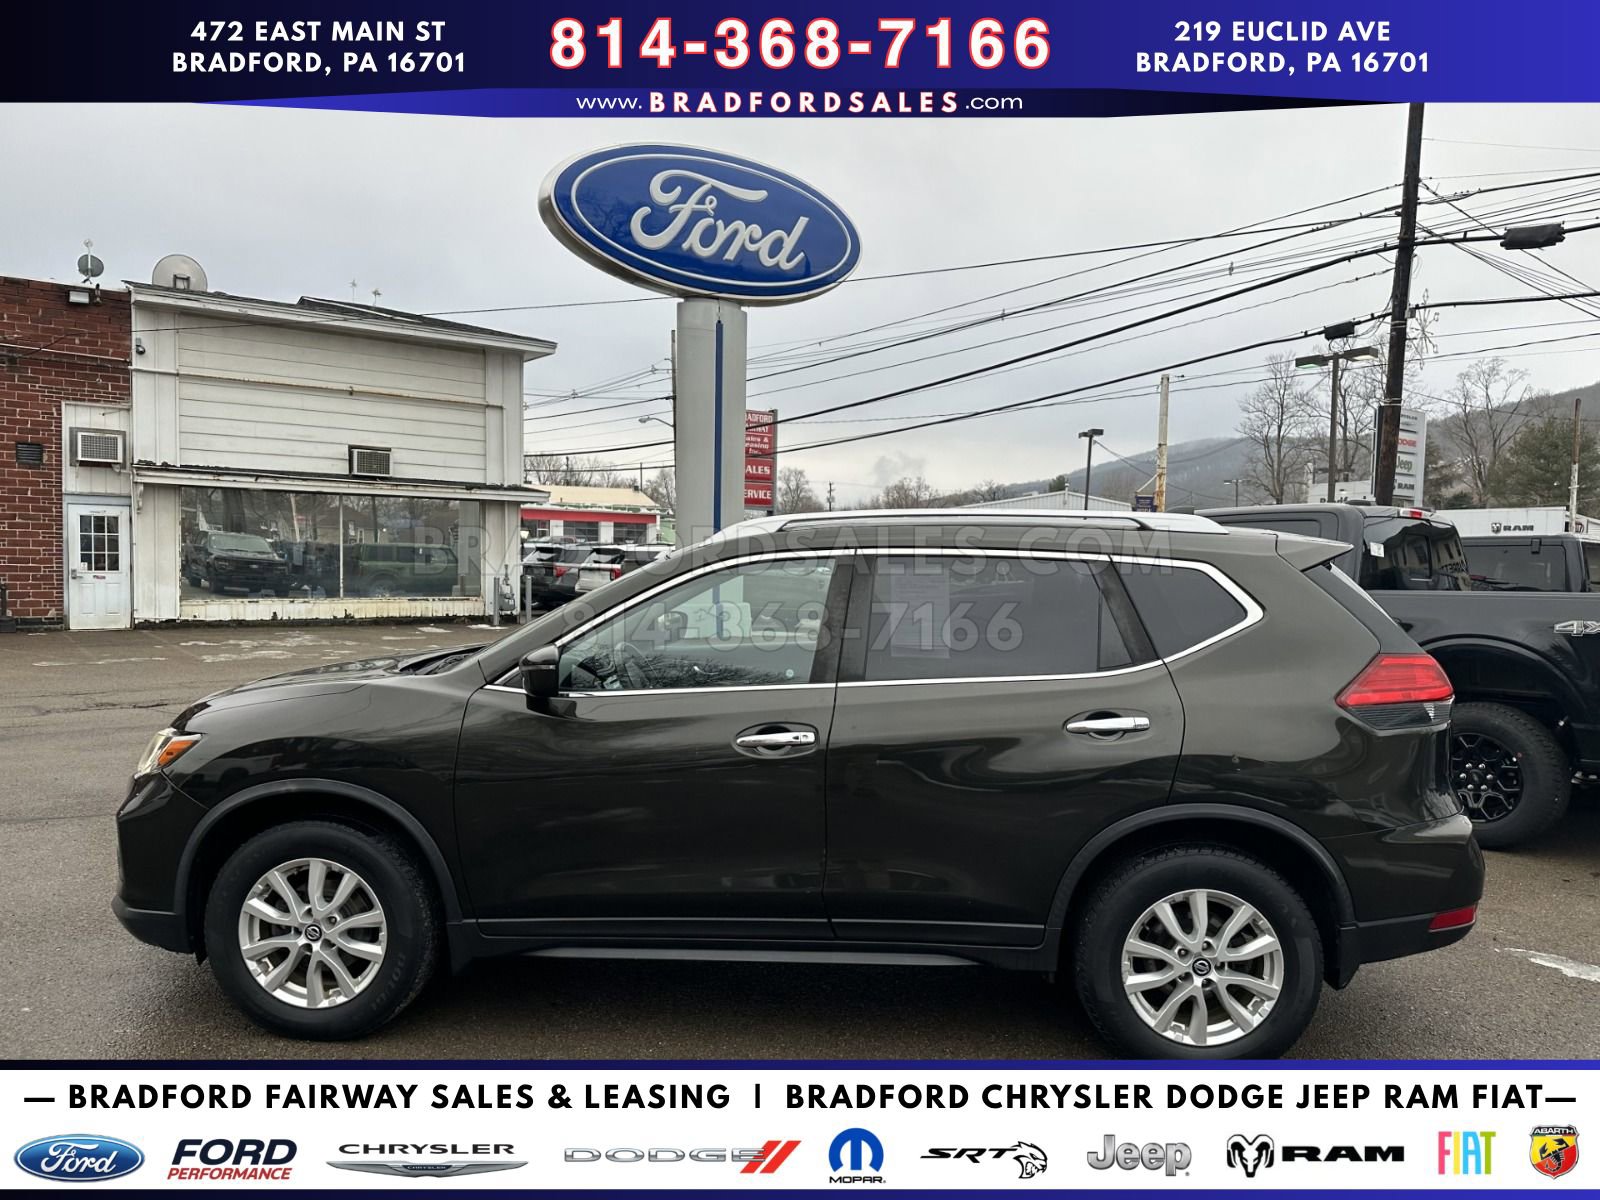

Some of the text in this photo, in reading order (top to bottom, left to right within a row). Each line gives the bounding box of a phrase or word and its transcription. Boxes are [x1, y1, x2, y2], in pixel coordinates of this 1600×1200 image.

[630, 169, 809, 271] Ford
[745, 412, 772, 423] ADFORD
[745, 465, 770, 475] ALES
[744, 489, 772, 499] ERVICE
[1503, 524, 1534, 532] RAM
